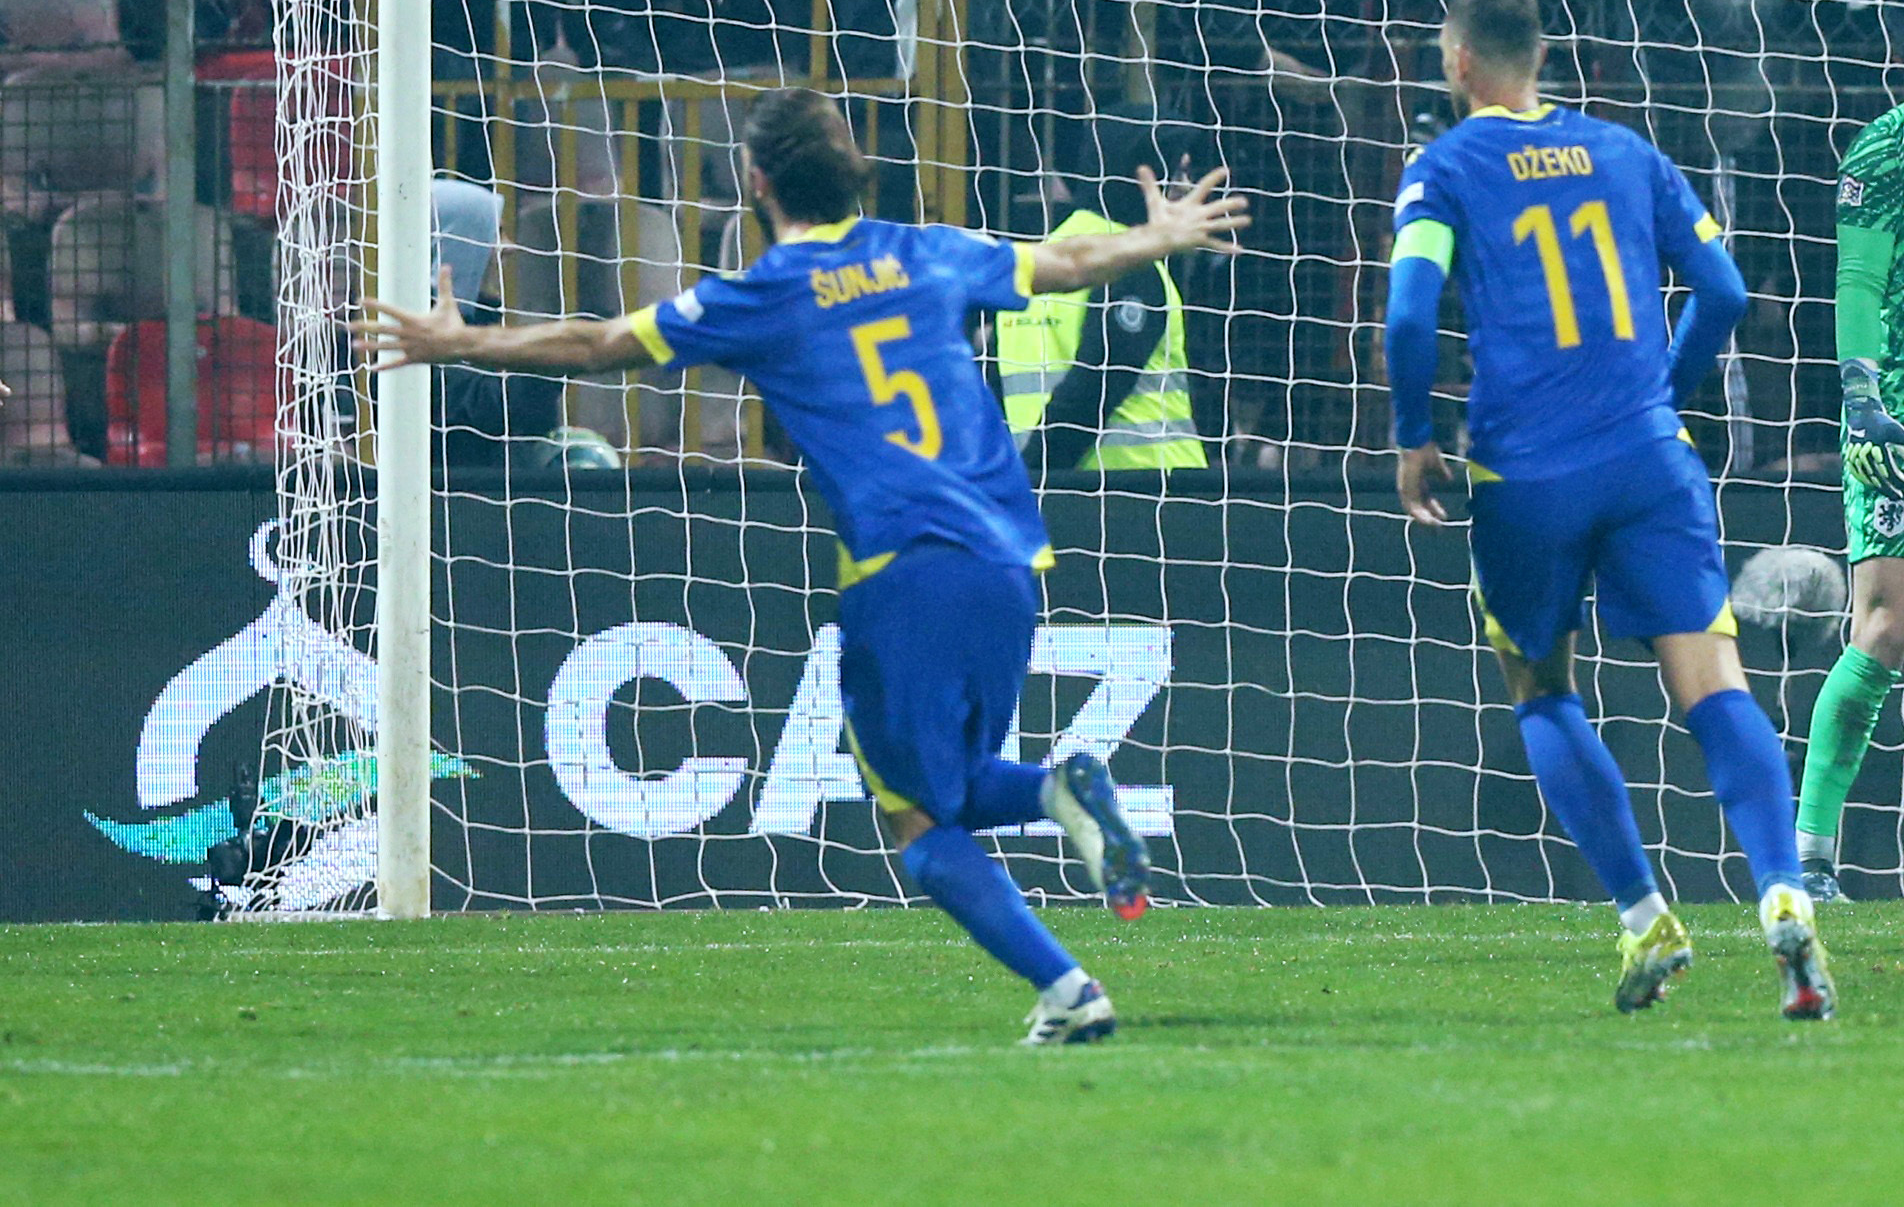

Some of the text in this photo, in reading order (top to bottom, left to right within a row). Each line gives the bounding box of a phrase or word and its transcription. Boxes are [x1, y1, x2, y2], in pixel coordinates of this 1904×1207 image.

[1506, 145, 1595, 181] DŽEKO
[1512, 199, 1637, 350] 11
[849, 315, 944, 462] 5
